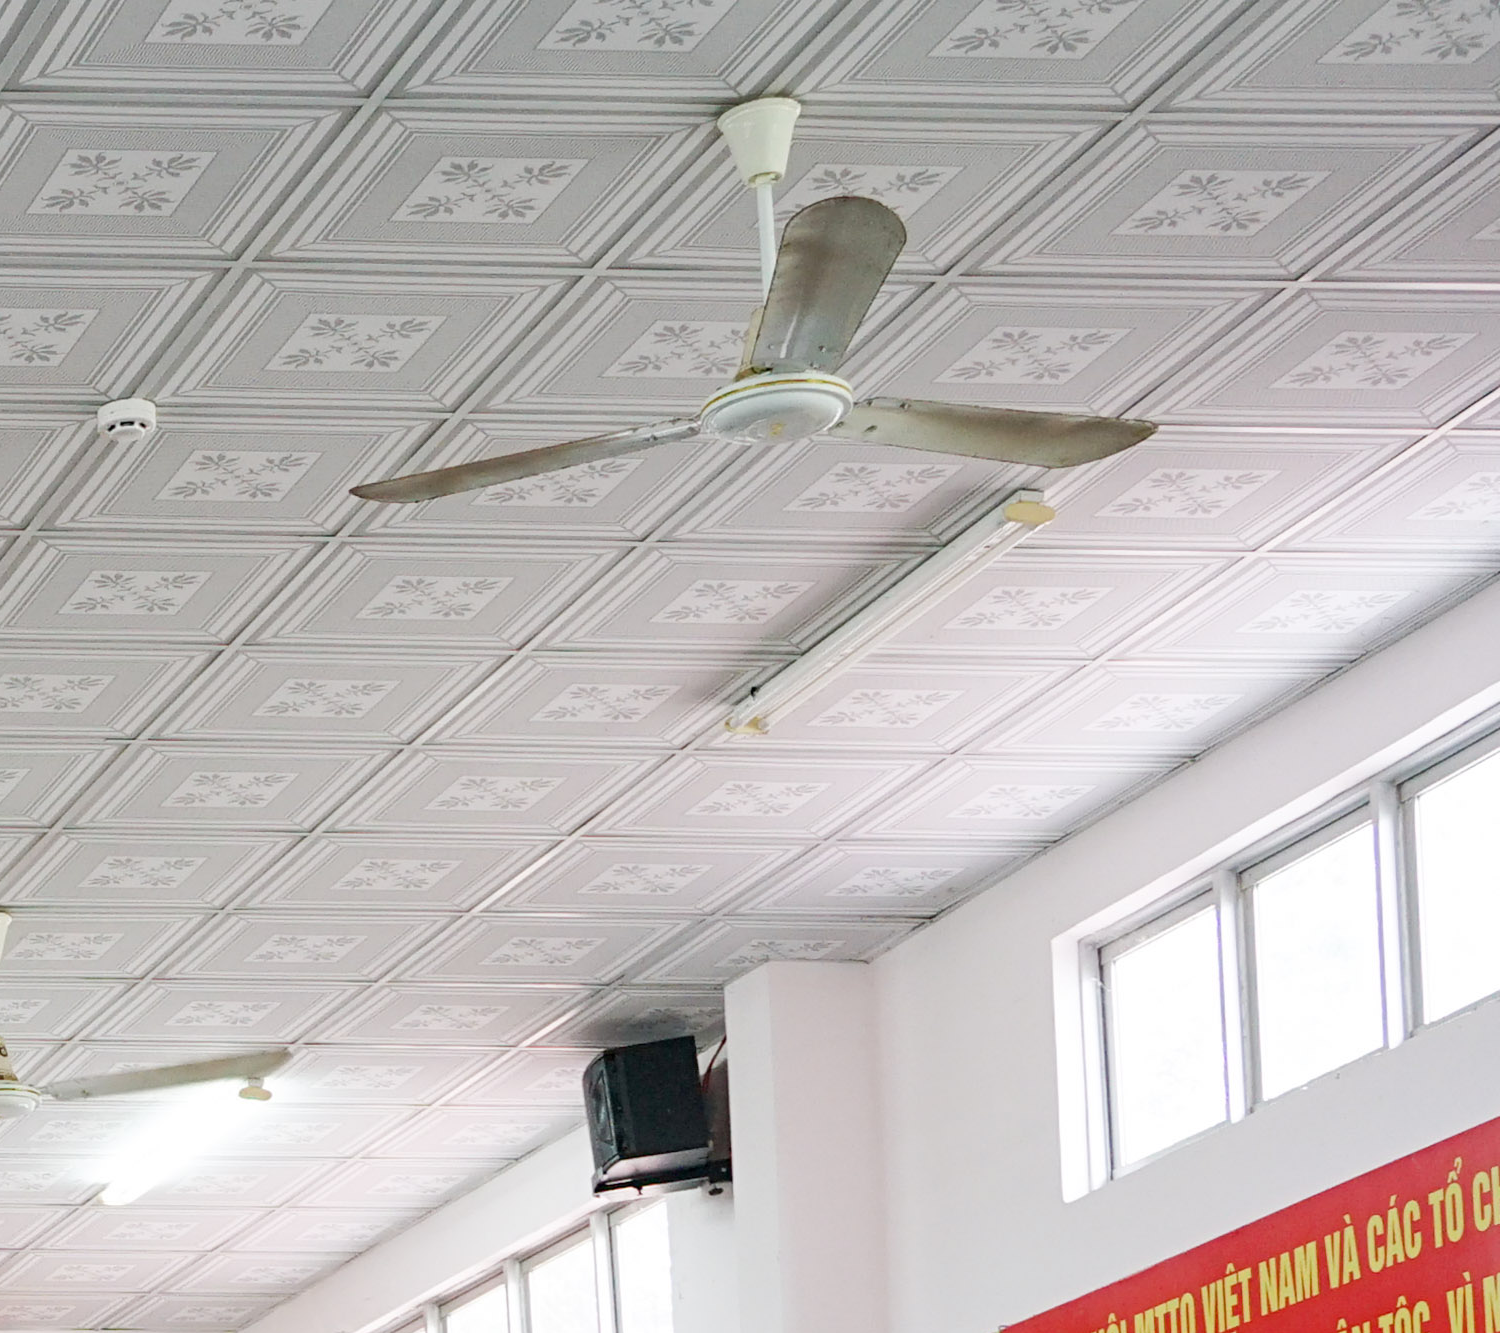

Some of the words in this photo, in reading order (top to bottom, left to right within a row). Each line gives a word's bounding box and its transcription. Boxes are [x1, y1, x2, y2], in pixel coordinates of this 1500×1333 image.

[1259, 1241, 1319, 1315] NAM
[1324, 1214, 1361, 1288] VÀ
[1367, 1195, 1421, 1272] CÁC
[1428, 1157, 1464, 1248] TỔ
